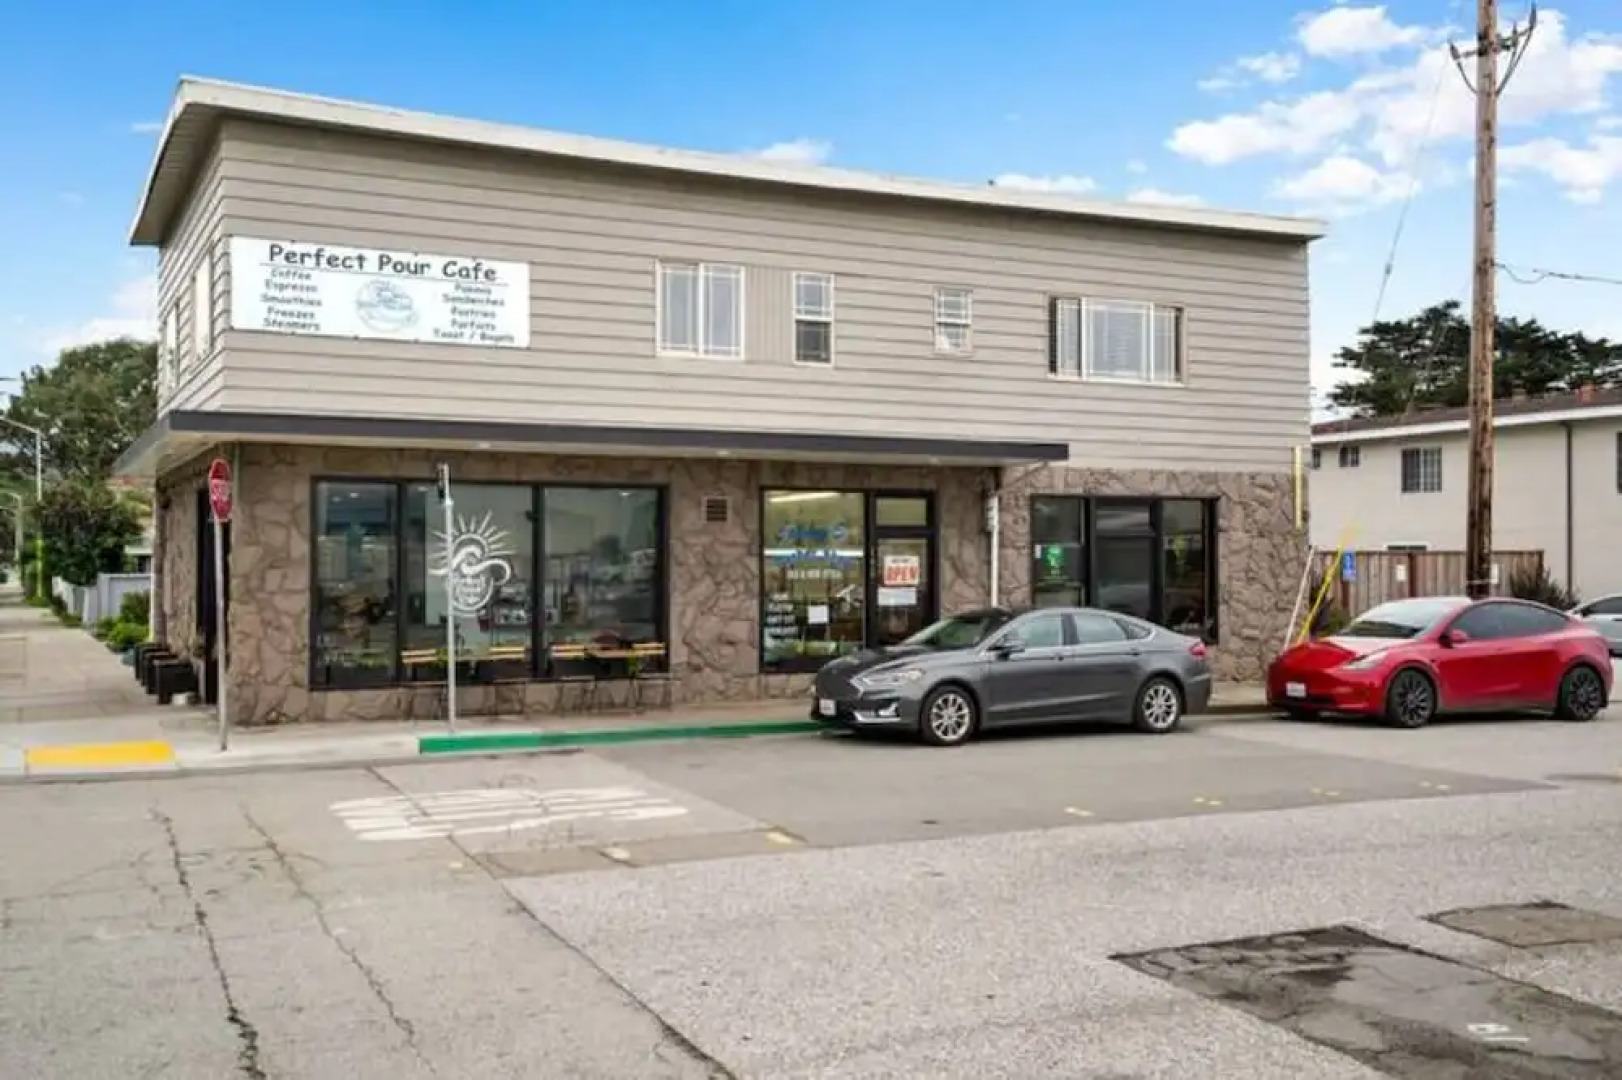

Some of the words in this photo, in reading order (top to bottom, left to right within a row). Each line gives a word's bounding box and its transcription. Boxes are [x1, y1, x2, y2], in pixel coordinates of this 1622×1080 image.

[268, 244, 367, 270] Perfect
[378, 254, 431, 276] Pour
[442, 260, 497, 281] Cafe
[271, 269, 311, 280] Coffee
[264, 279, 318, 292] Espresso
[260, 292, 322, 307] Smoothies
[441, 292, 505, 306] Sandwiches
[266, 305, 316, 319] Freezes
[451, 305, 496, 319] Pastries
[262, 317, 321, 331] Steamers
[432, 327, 464, 339] Toast
[886, 565, 918, 581] OPEN
